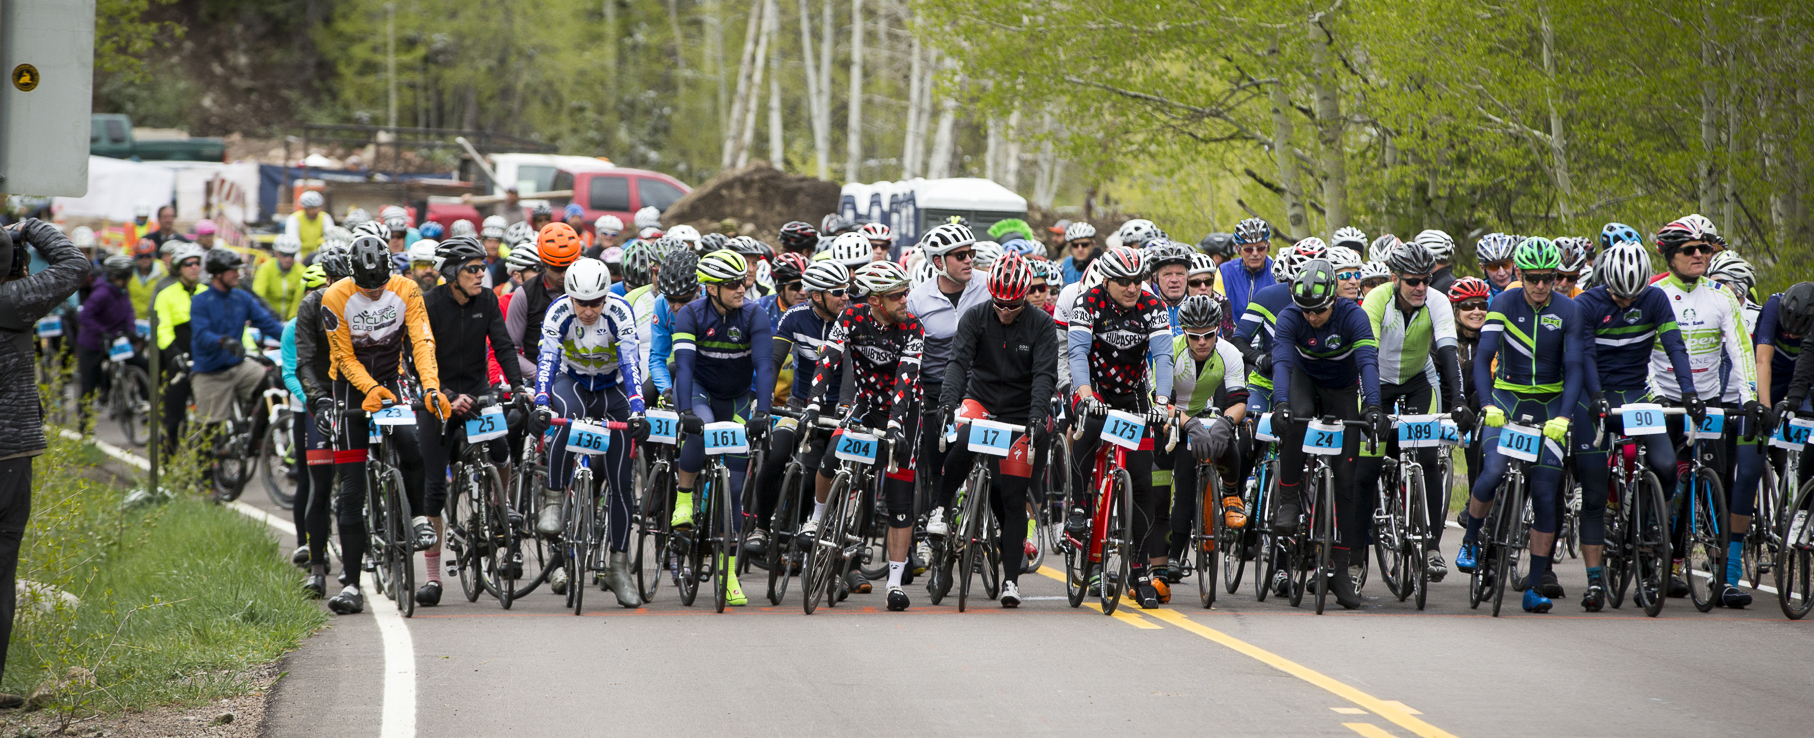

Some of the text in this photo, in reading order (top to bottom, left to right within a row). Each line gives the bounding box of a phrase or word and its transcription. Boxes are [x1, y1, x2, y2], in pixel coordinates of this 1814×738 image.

[353, 310, 397, 324] CYCLING
[372, 304, 395, 316] ASPEN
[384, 408, 402, 418] 23
[1635, 411, 1653, 426] 90
[478, 416, 495, 433] 25
[655, 419, 670, 435] 31
[1110, 419, 1138, 440] 175
[1407, 424, 1431, 439] 189
[575, 432, 602, 450] 136
[712, 430, 738, 447] 161
[981, 429, 999, 445] 17
[1315, 432, 1334, 447] 24
[1440, 426, 1459, 441] 12
[843, 438, 871, 456] 204
[1507, 433, 1532, 452] 101
